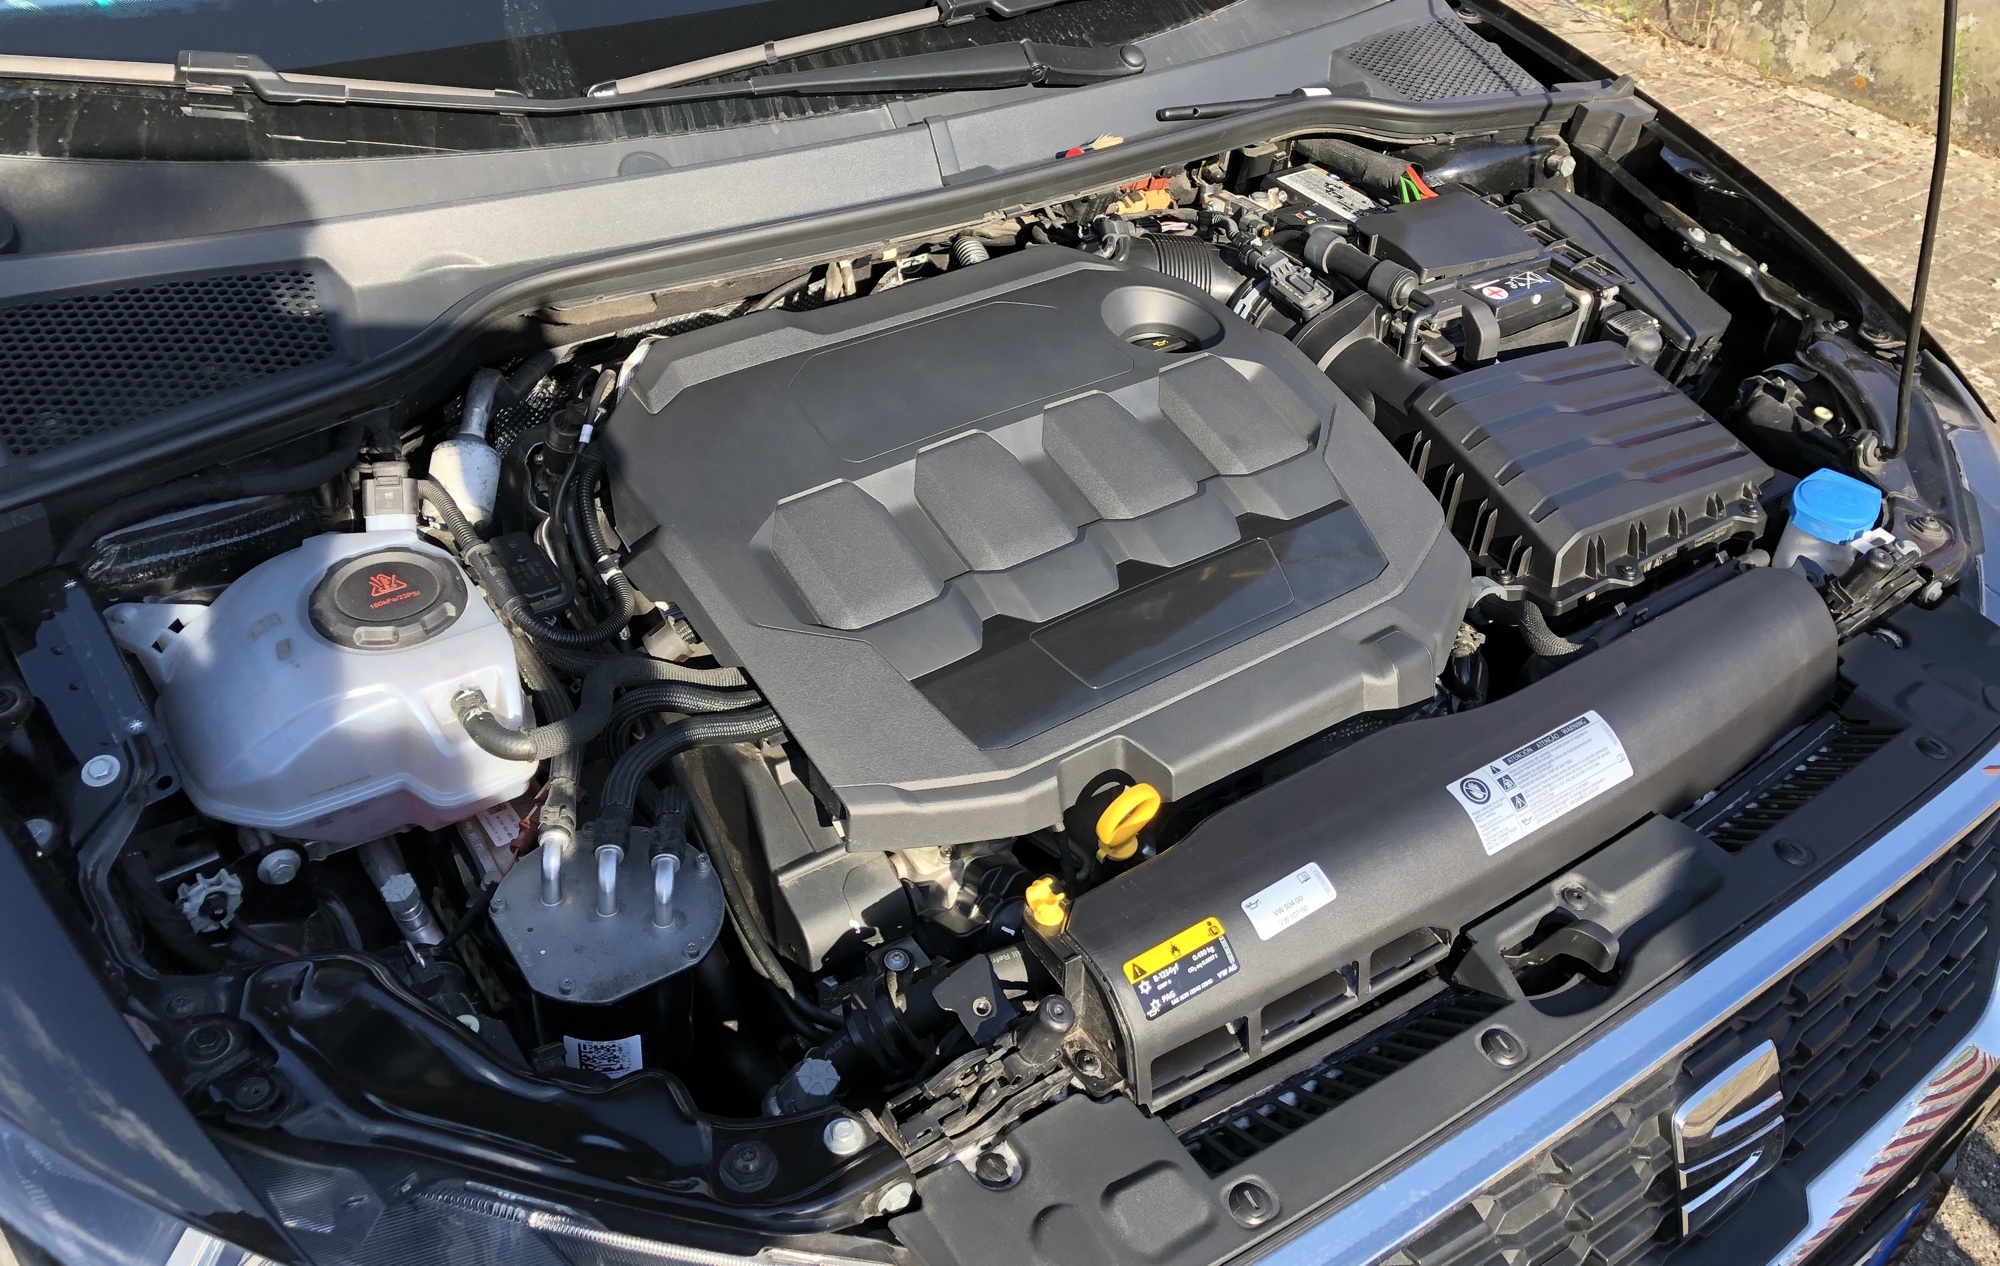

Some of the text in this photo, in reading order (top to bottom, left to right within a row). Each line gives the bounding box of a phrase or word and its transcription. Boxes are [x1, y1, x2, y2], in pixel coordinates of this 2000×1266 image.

[1507, 746, 1533, 764] ATENCIÓN
[1536, 733, 1560, 748] ATENÇÃO
[1561, 718, 1586, 735] WARNING
[1272, 906, 1285, 916] VW
[1284, 900, 1295, 911] 504
[1278, 916, 1290, 926] VW
[1290, 910, 1300, 920] 507
[1153, 962, 1179, 982] R-1234yf
[1207, 946, 1216, 954] kg
[1217, 963, 1238, 979] VW AG
[1161, 990, 1176, 1003] PAG
